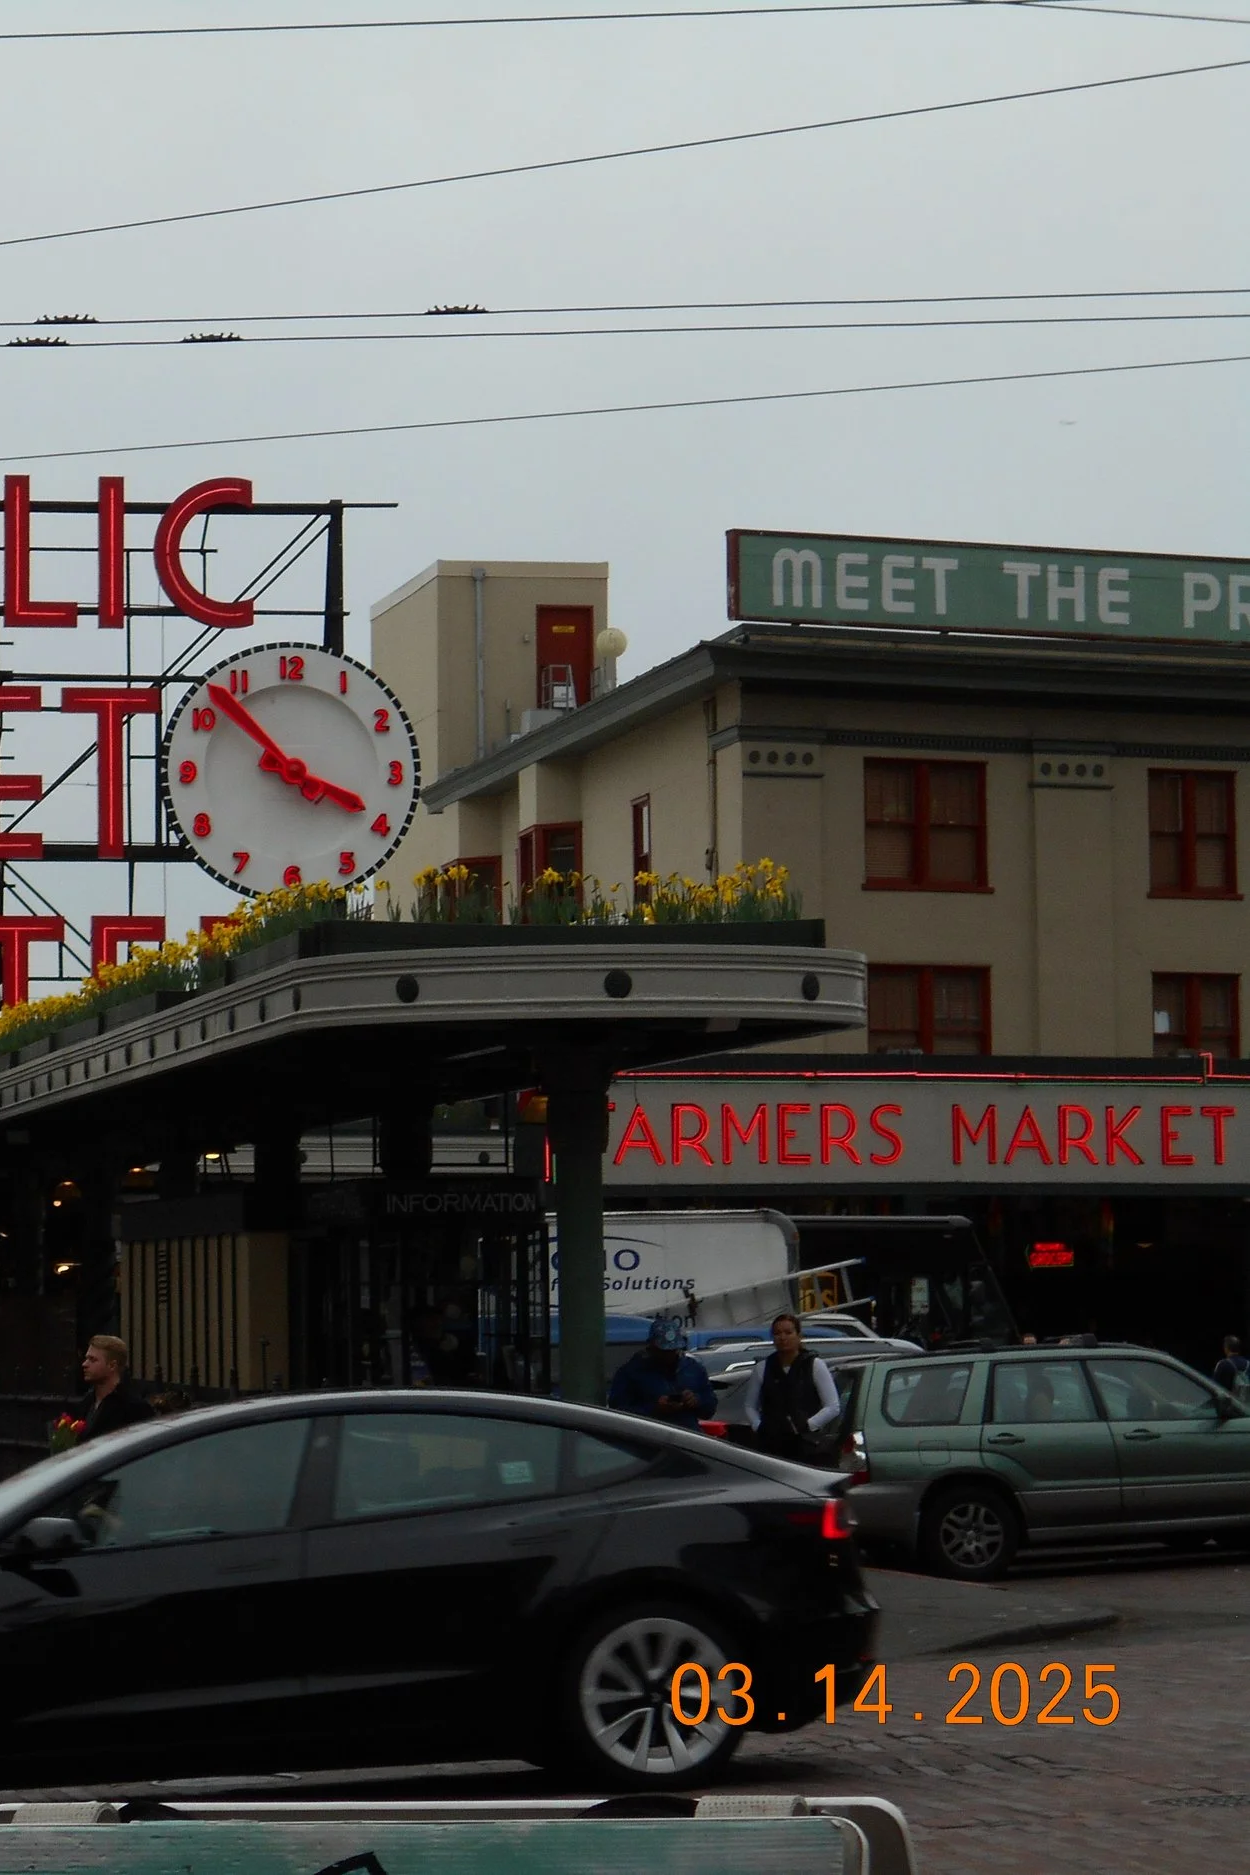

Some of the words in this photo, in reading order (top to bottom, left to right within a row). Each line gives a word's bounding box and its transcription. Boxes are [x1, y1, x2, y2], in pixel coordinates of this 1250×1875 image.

[772, 547, 958, 616] MEET
[1002, 560, 1130, 626] THE
[279, 655, 305, 681] 12
[230, 669, 248, 694] 11
[340, 670, 348, 694] 1
[192, 707, 217, 732] 10
[373, 708, 391, 733] 2
[178, 760, 198, 785] 9
[387, 760, 404, 785] 3
[193, 812, 212, 838] 8
[370, 812, 391, 837] 4
[232, 851, 250, 875] 7
[338, 851, 356, 875] 5
[282, 865, 302, 888] 6
[607, 1102, 903, 1167] ARMERS
[952, 1103, 1236, 1168] MARKET
[386, 1192, 537, 1214] INFORMATION
[603, 1275, 695, 1291] Solutions
